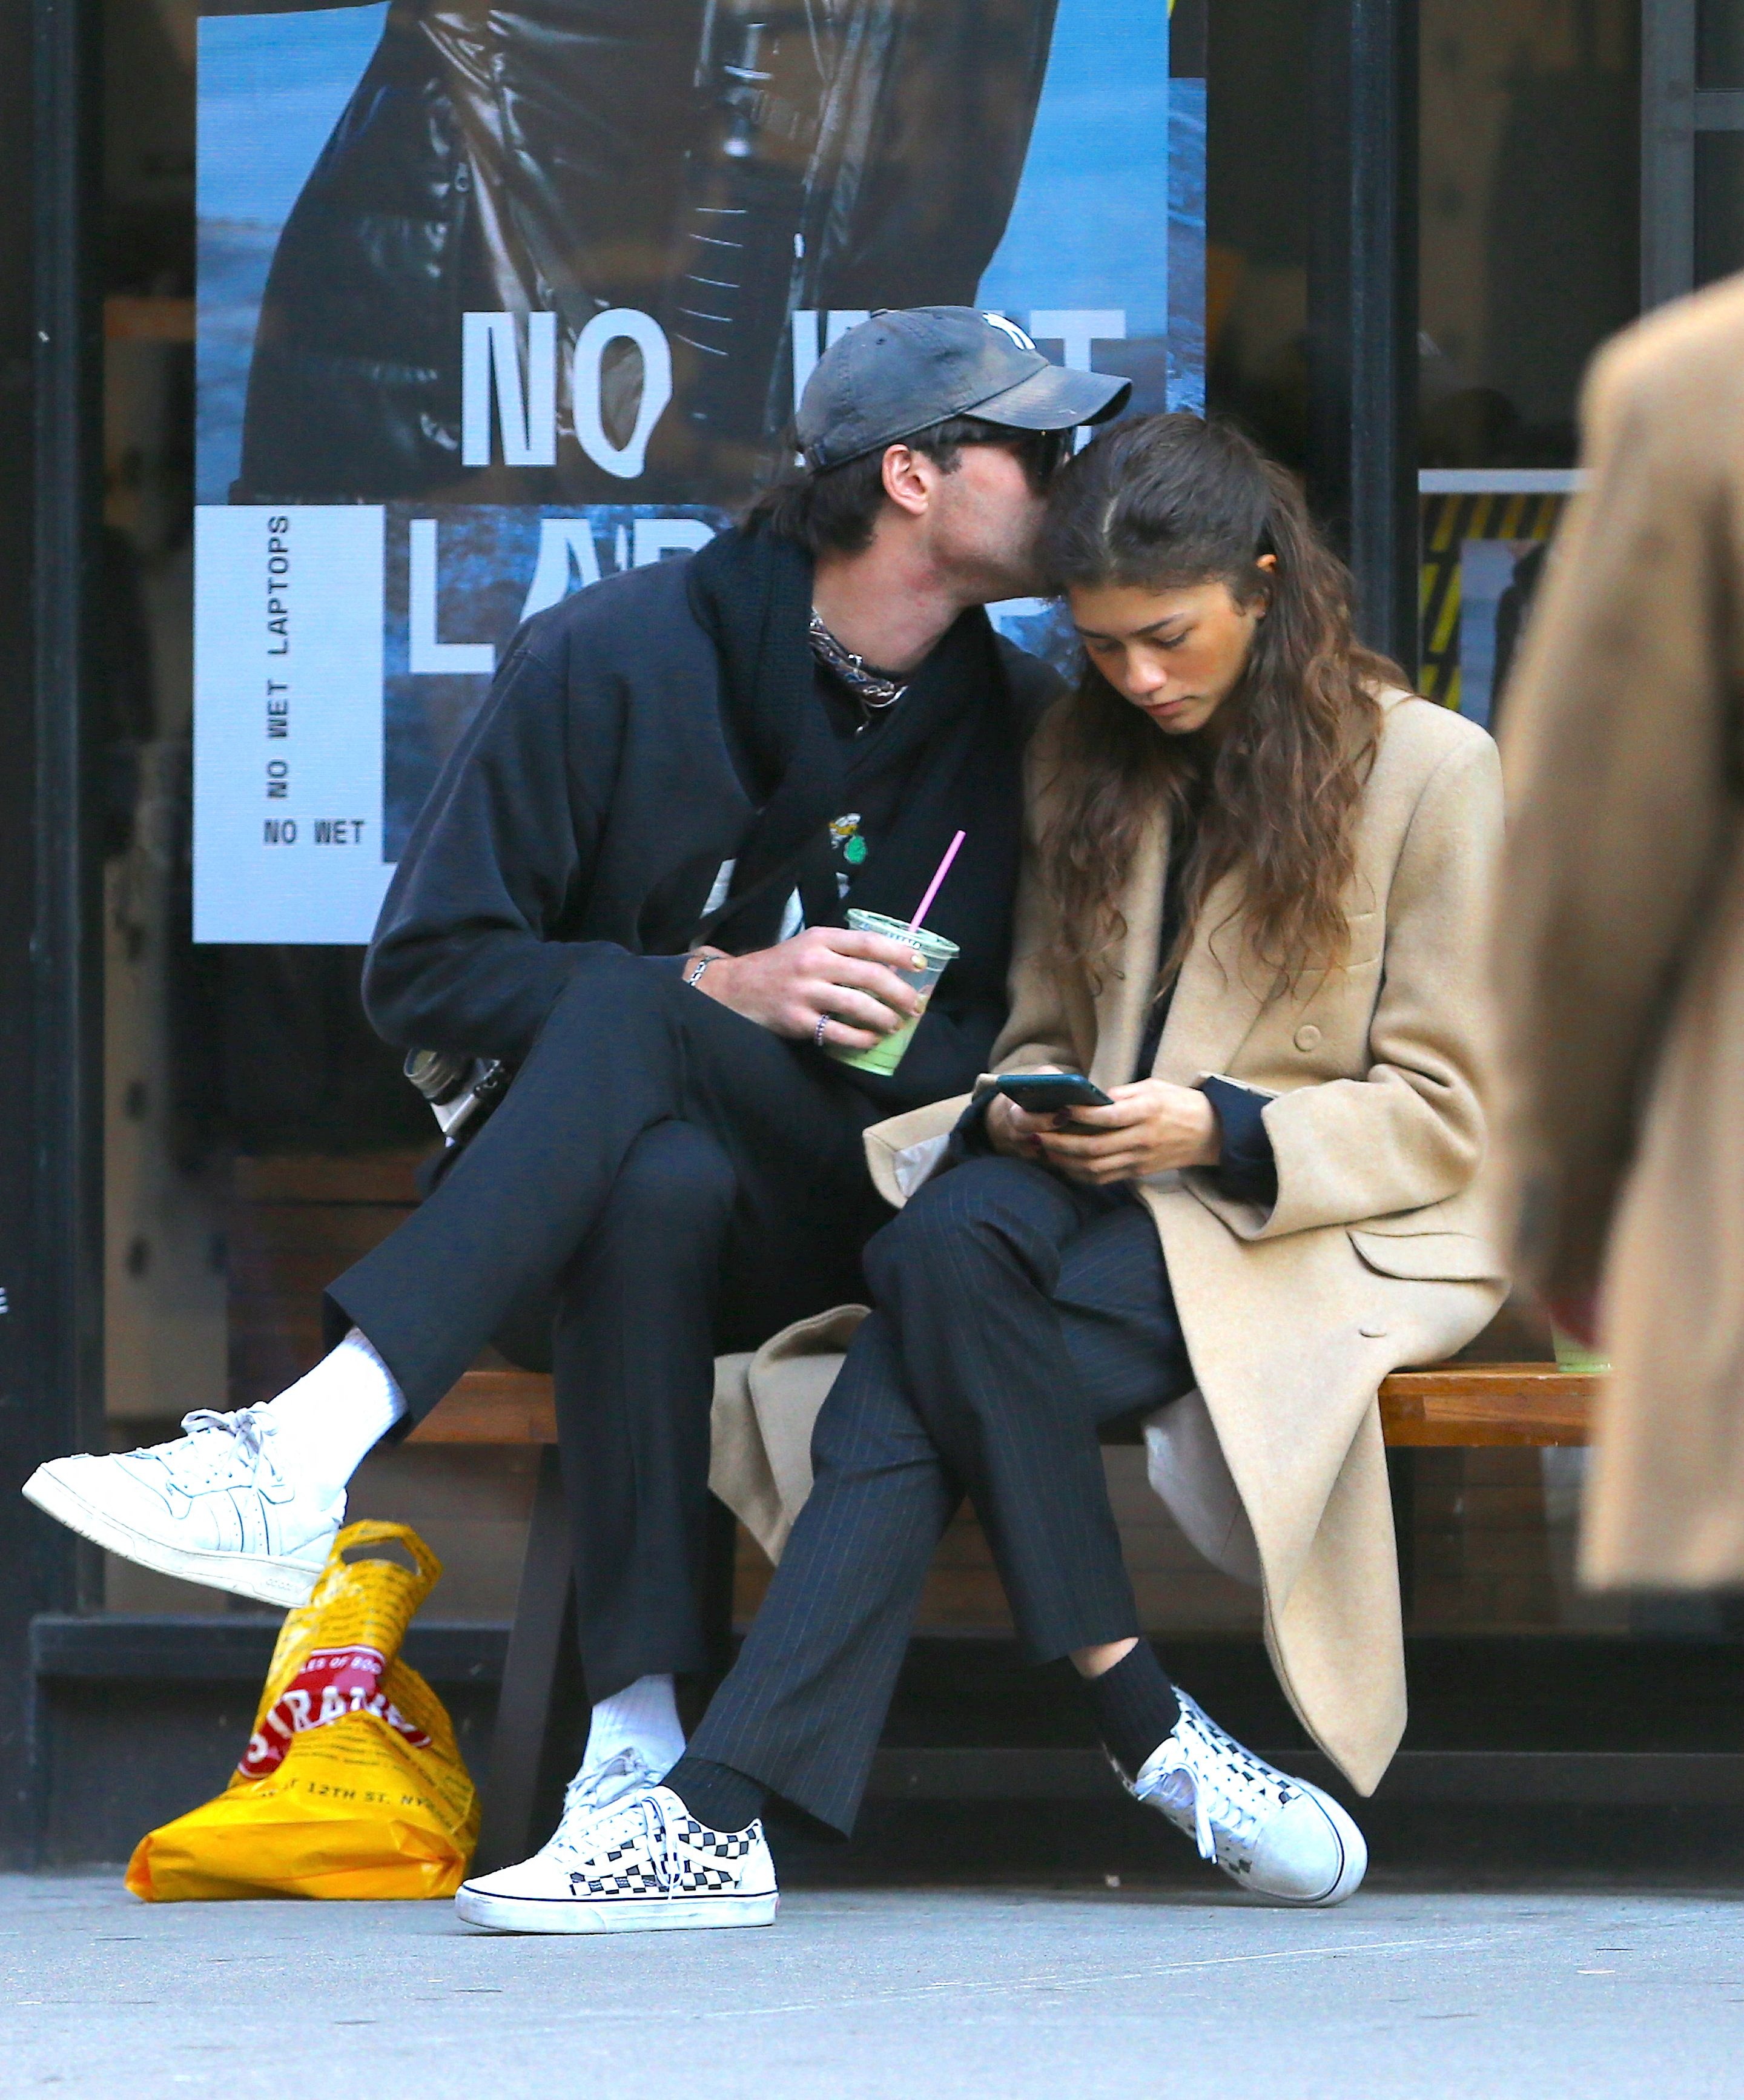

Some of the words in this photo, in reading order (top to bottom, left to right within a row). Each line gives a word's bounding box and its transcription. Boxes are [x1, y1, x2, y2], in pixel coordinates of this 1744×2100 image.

[461, 308, 673, 479] NO
[266, 515, 289, 656] LAPTOPS
[266, 679, 289, 739] WET
[266, 759, 288, 799] NO
[263, 820, 297, 845] NO
[314, 819, 365, 845] WET
[308, 1781, 356, 1800] 12TH
[365, 1791, 391, 1805] ST.
